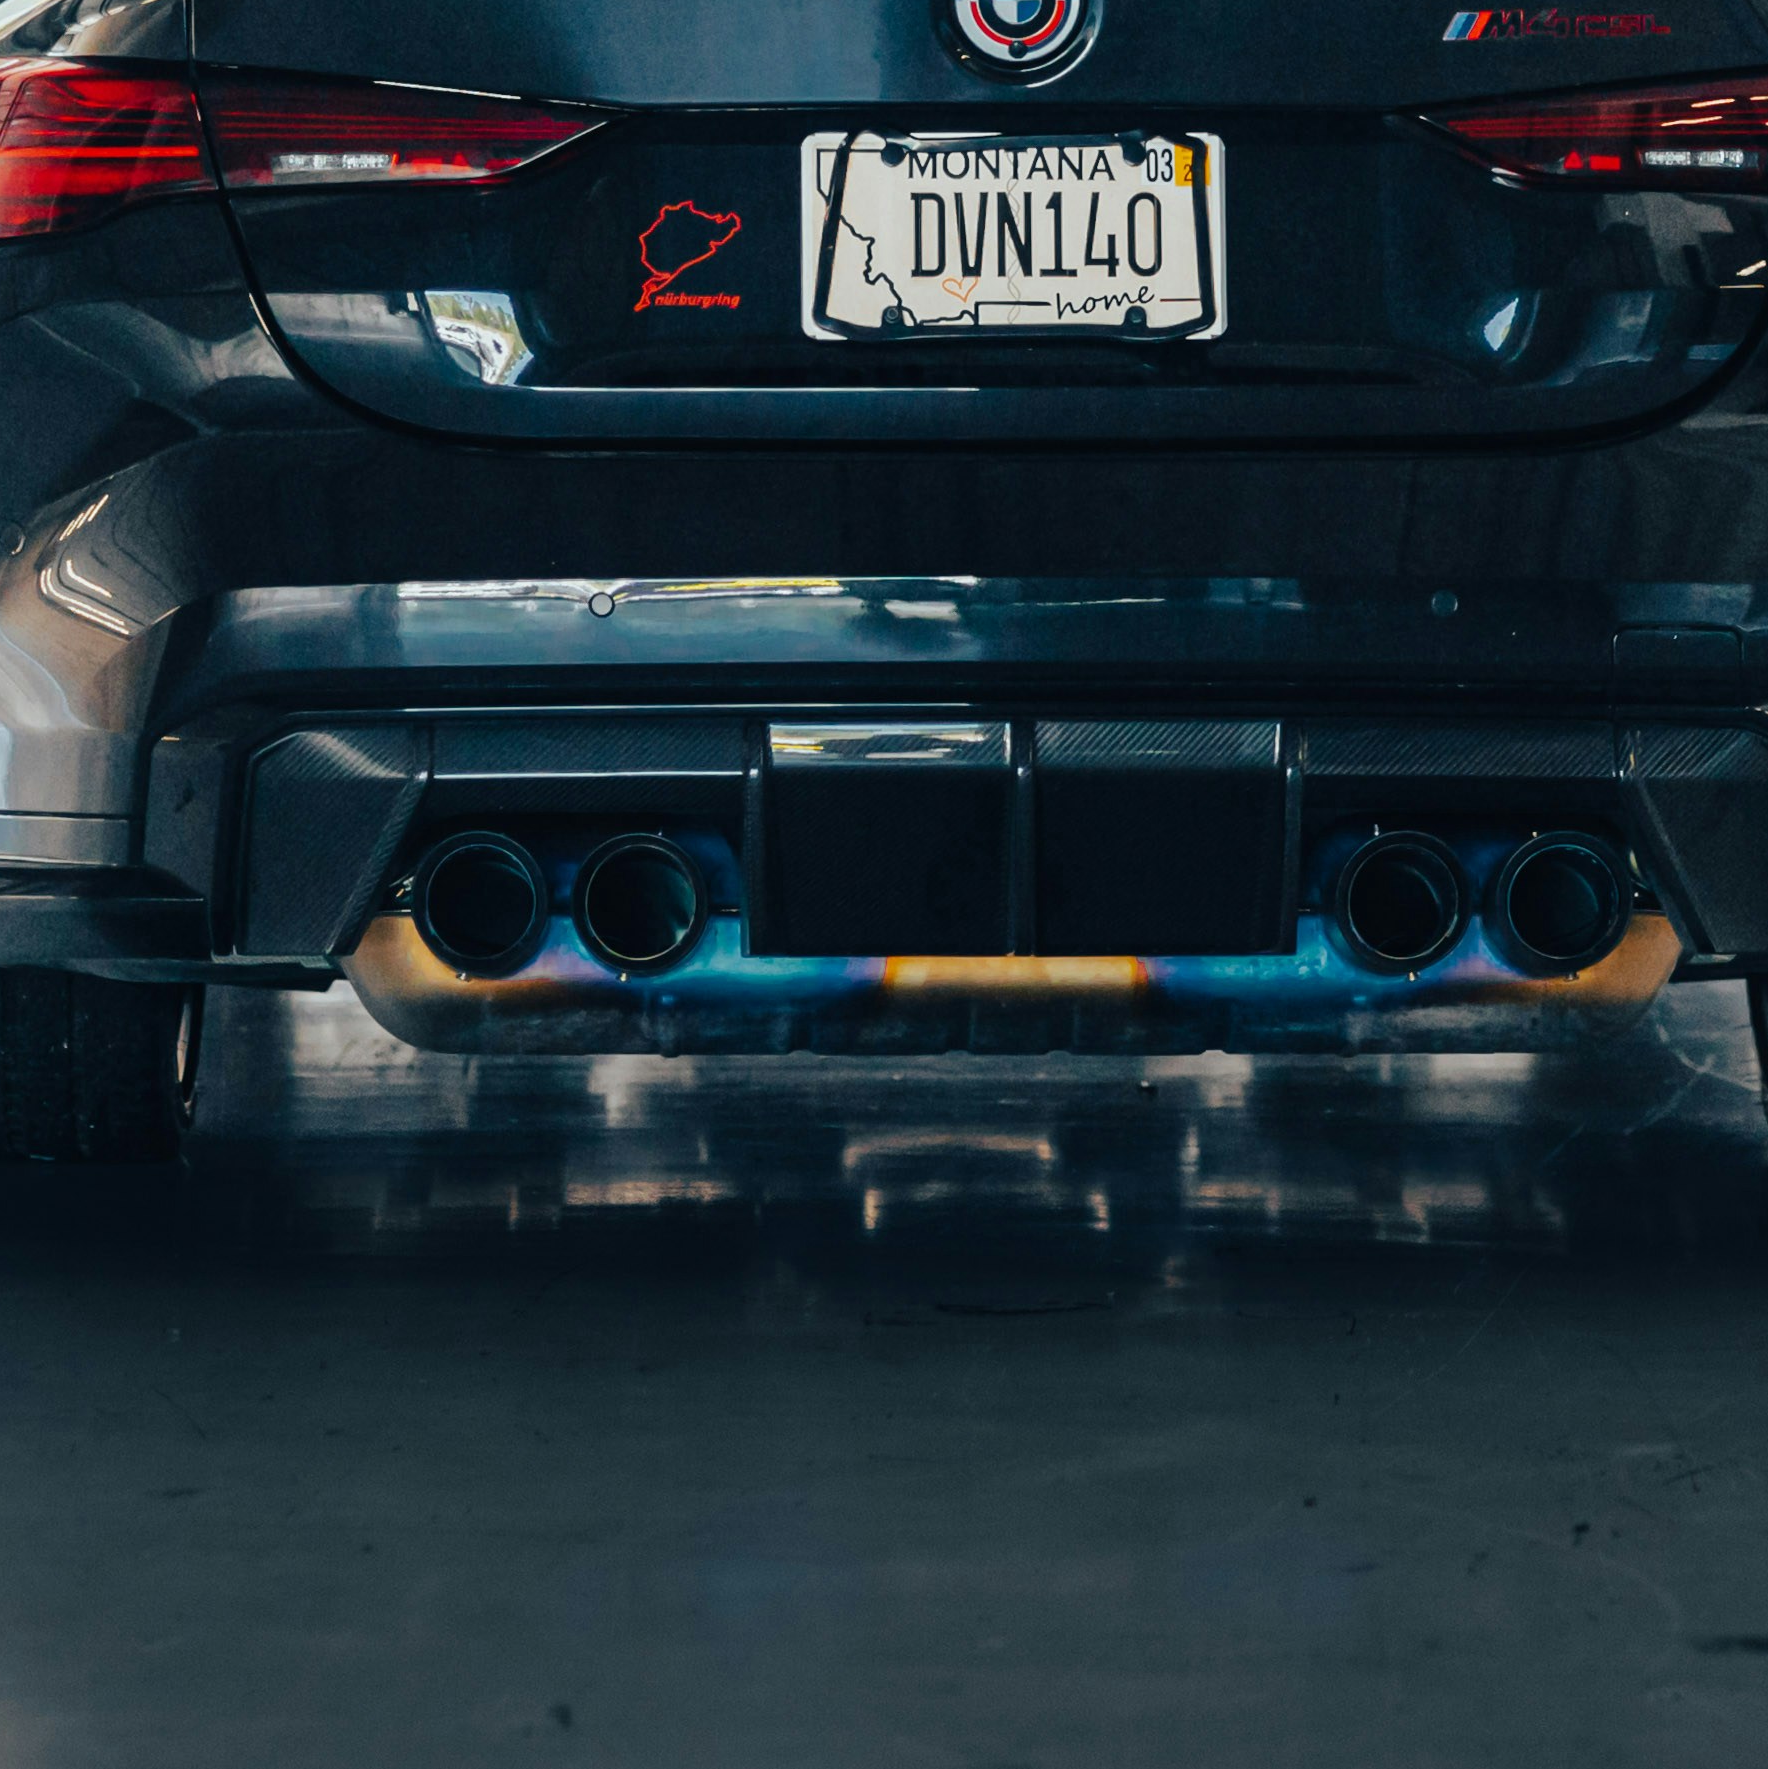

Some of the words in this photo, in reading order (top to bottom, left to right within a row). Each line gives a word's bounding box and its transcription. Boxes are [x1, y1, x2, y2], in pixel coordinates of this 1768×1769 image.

[908, 148, 1116, 181] MONTANA
[1146, 148, 1173, 182] 03
[910, 192, 1162, 277] DVN140
[1056, 286, 1155, 320] home
